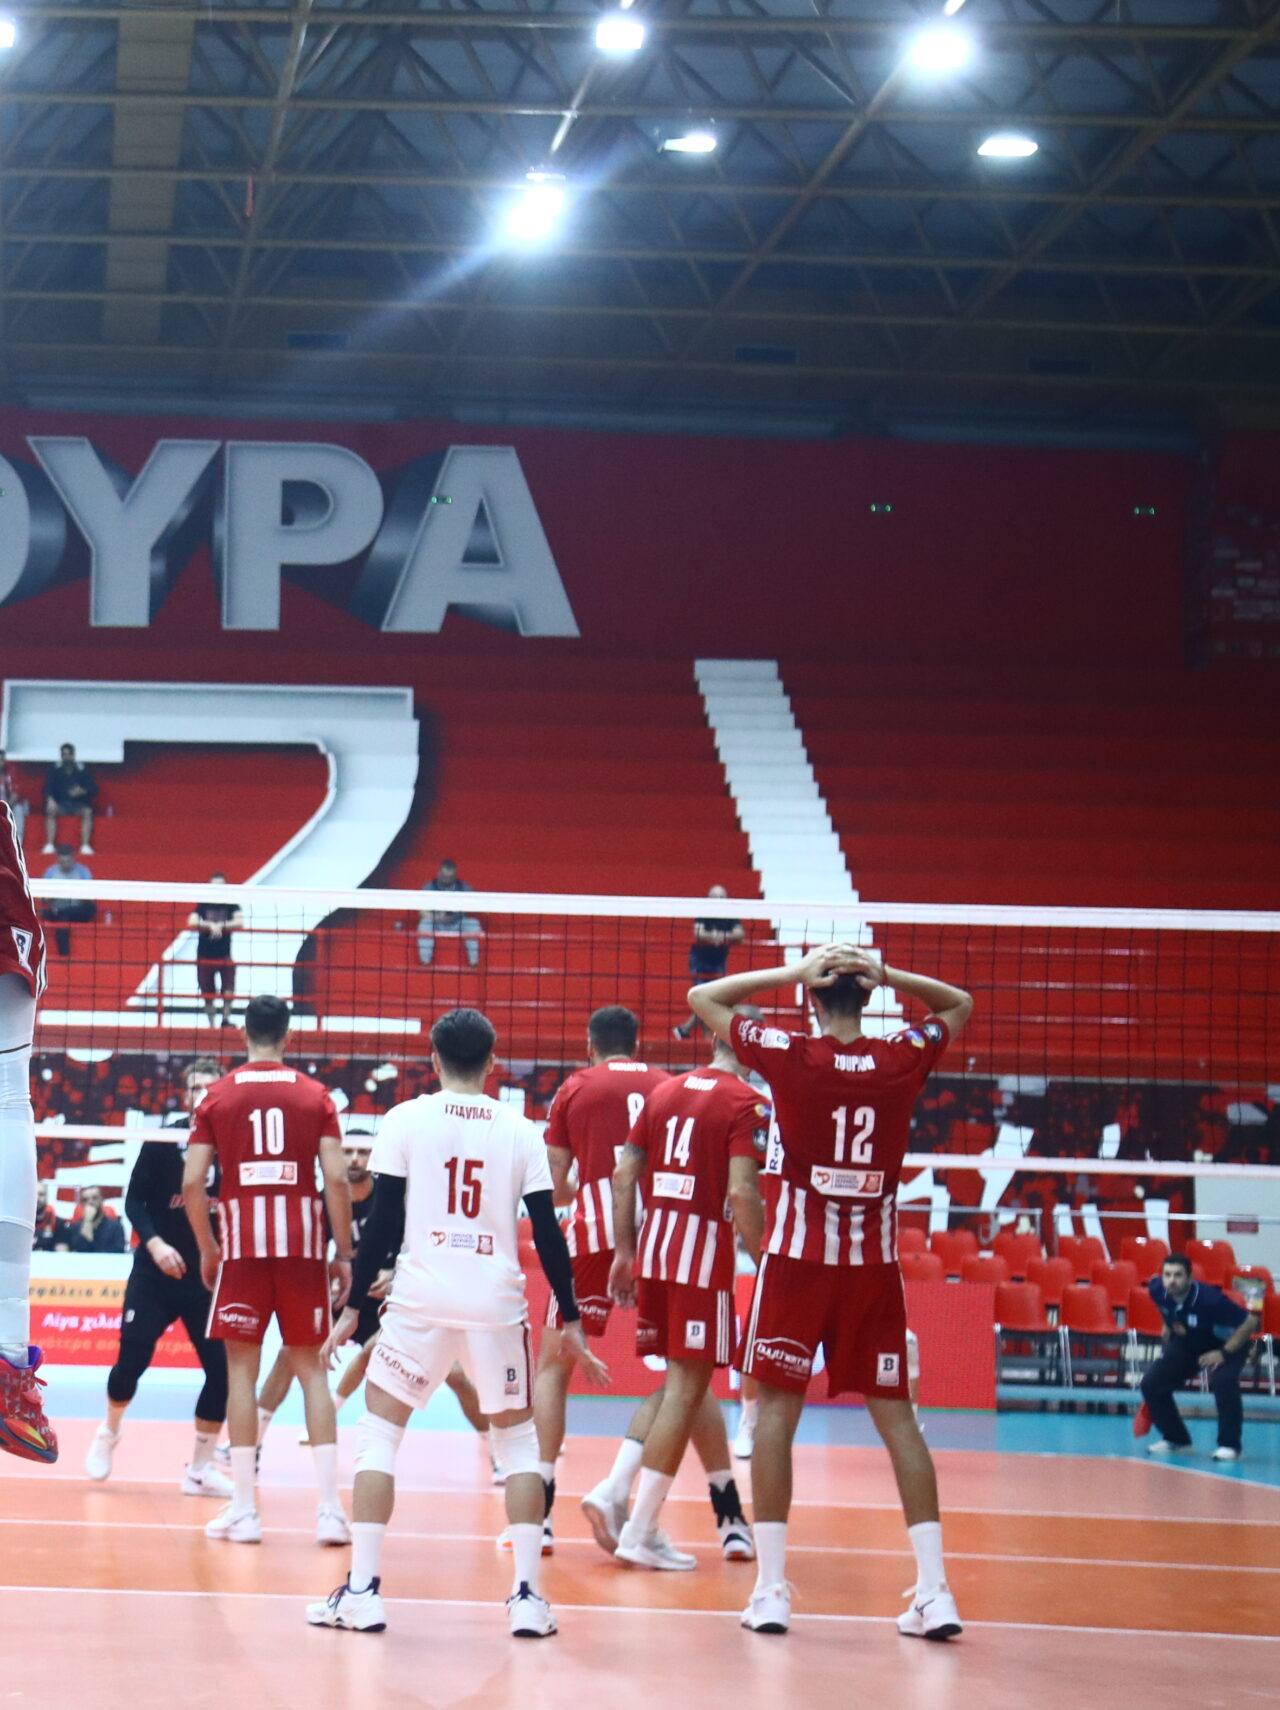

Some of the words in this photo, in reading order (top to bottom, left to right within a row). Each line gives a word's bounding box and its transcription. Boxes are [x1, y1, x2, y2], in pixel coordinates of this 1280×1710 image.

[248, 1107, 285, 1155] 10
[664, 1115, 695, 1167] 14
[831, 1105, 876, 1164] 12
[444, 1156, 484, 1219] 15
[506, 1368, 517, 1382] B
